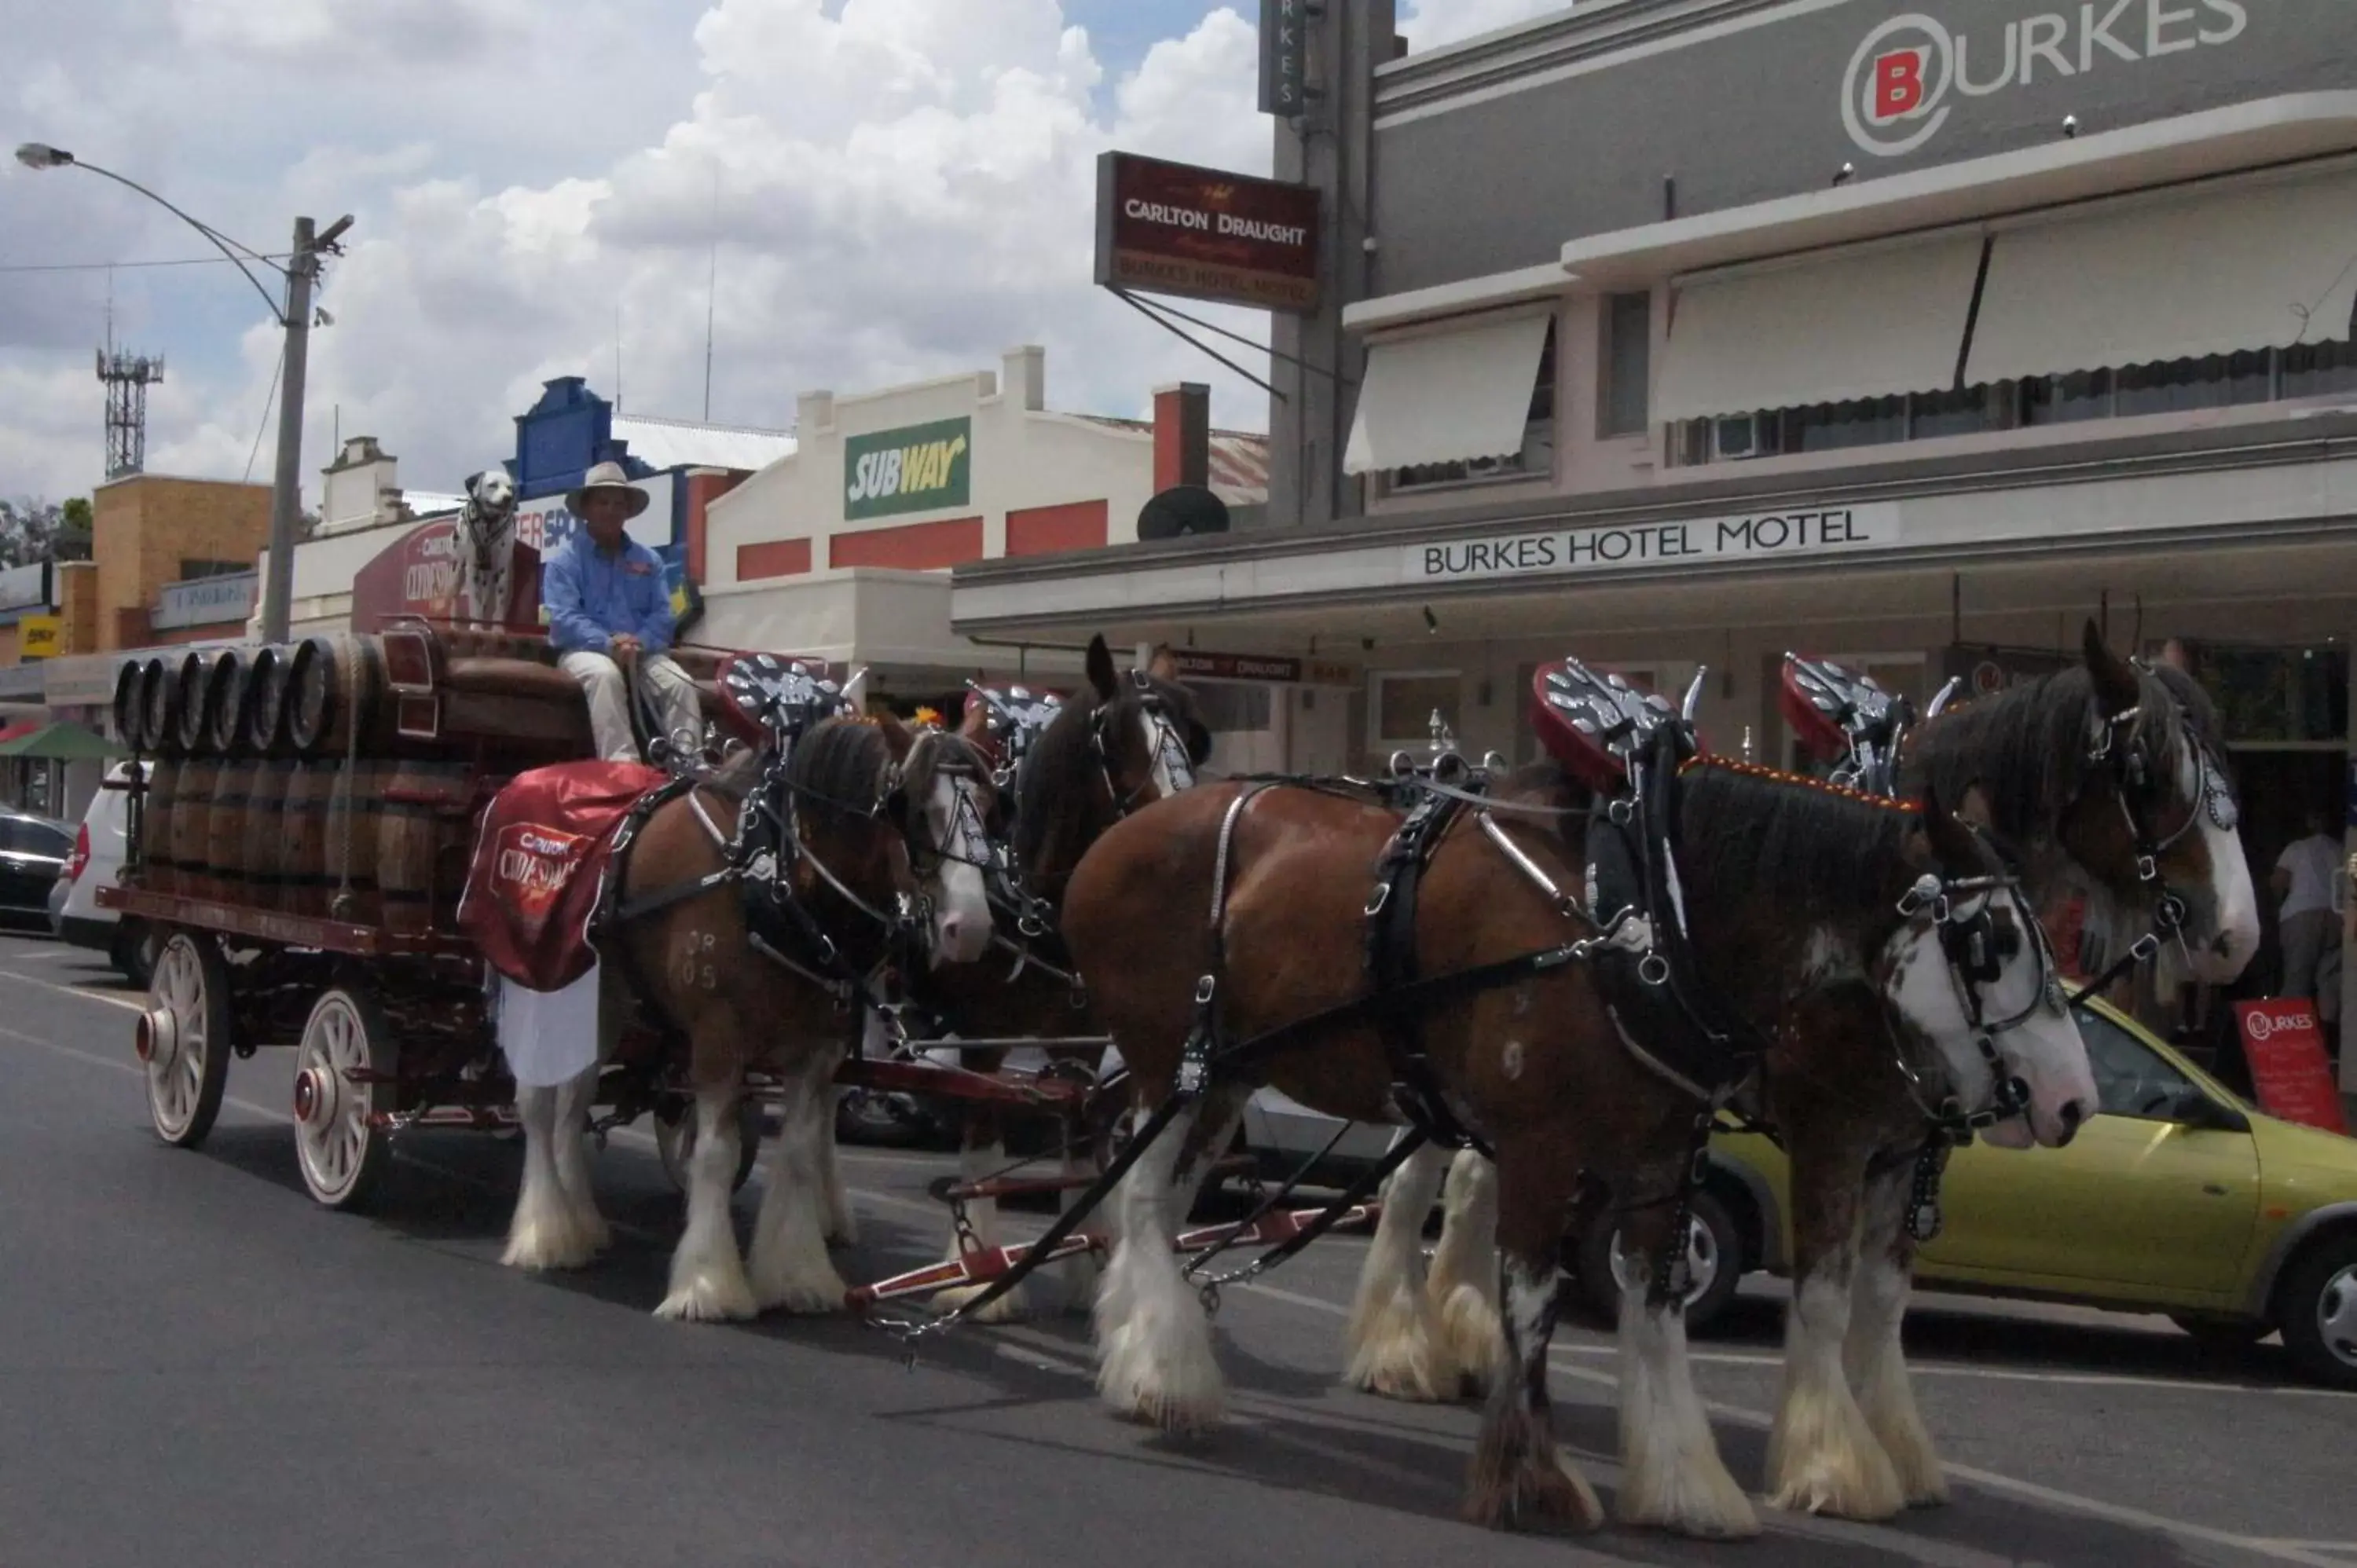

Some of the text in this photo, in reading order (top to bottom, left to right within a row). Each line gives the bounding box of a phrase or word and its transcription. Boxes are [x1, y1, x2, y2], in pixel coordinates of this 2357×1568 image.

[1124, 199, 1307, 247] CARLTON DRAUGHT
[849, 434, 966, 502] SUBWAY
[1424, 510, 1870, 575] BURKES HOTEL MOTEL
